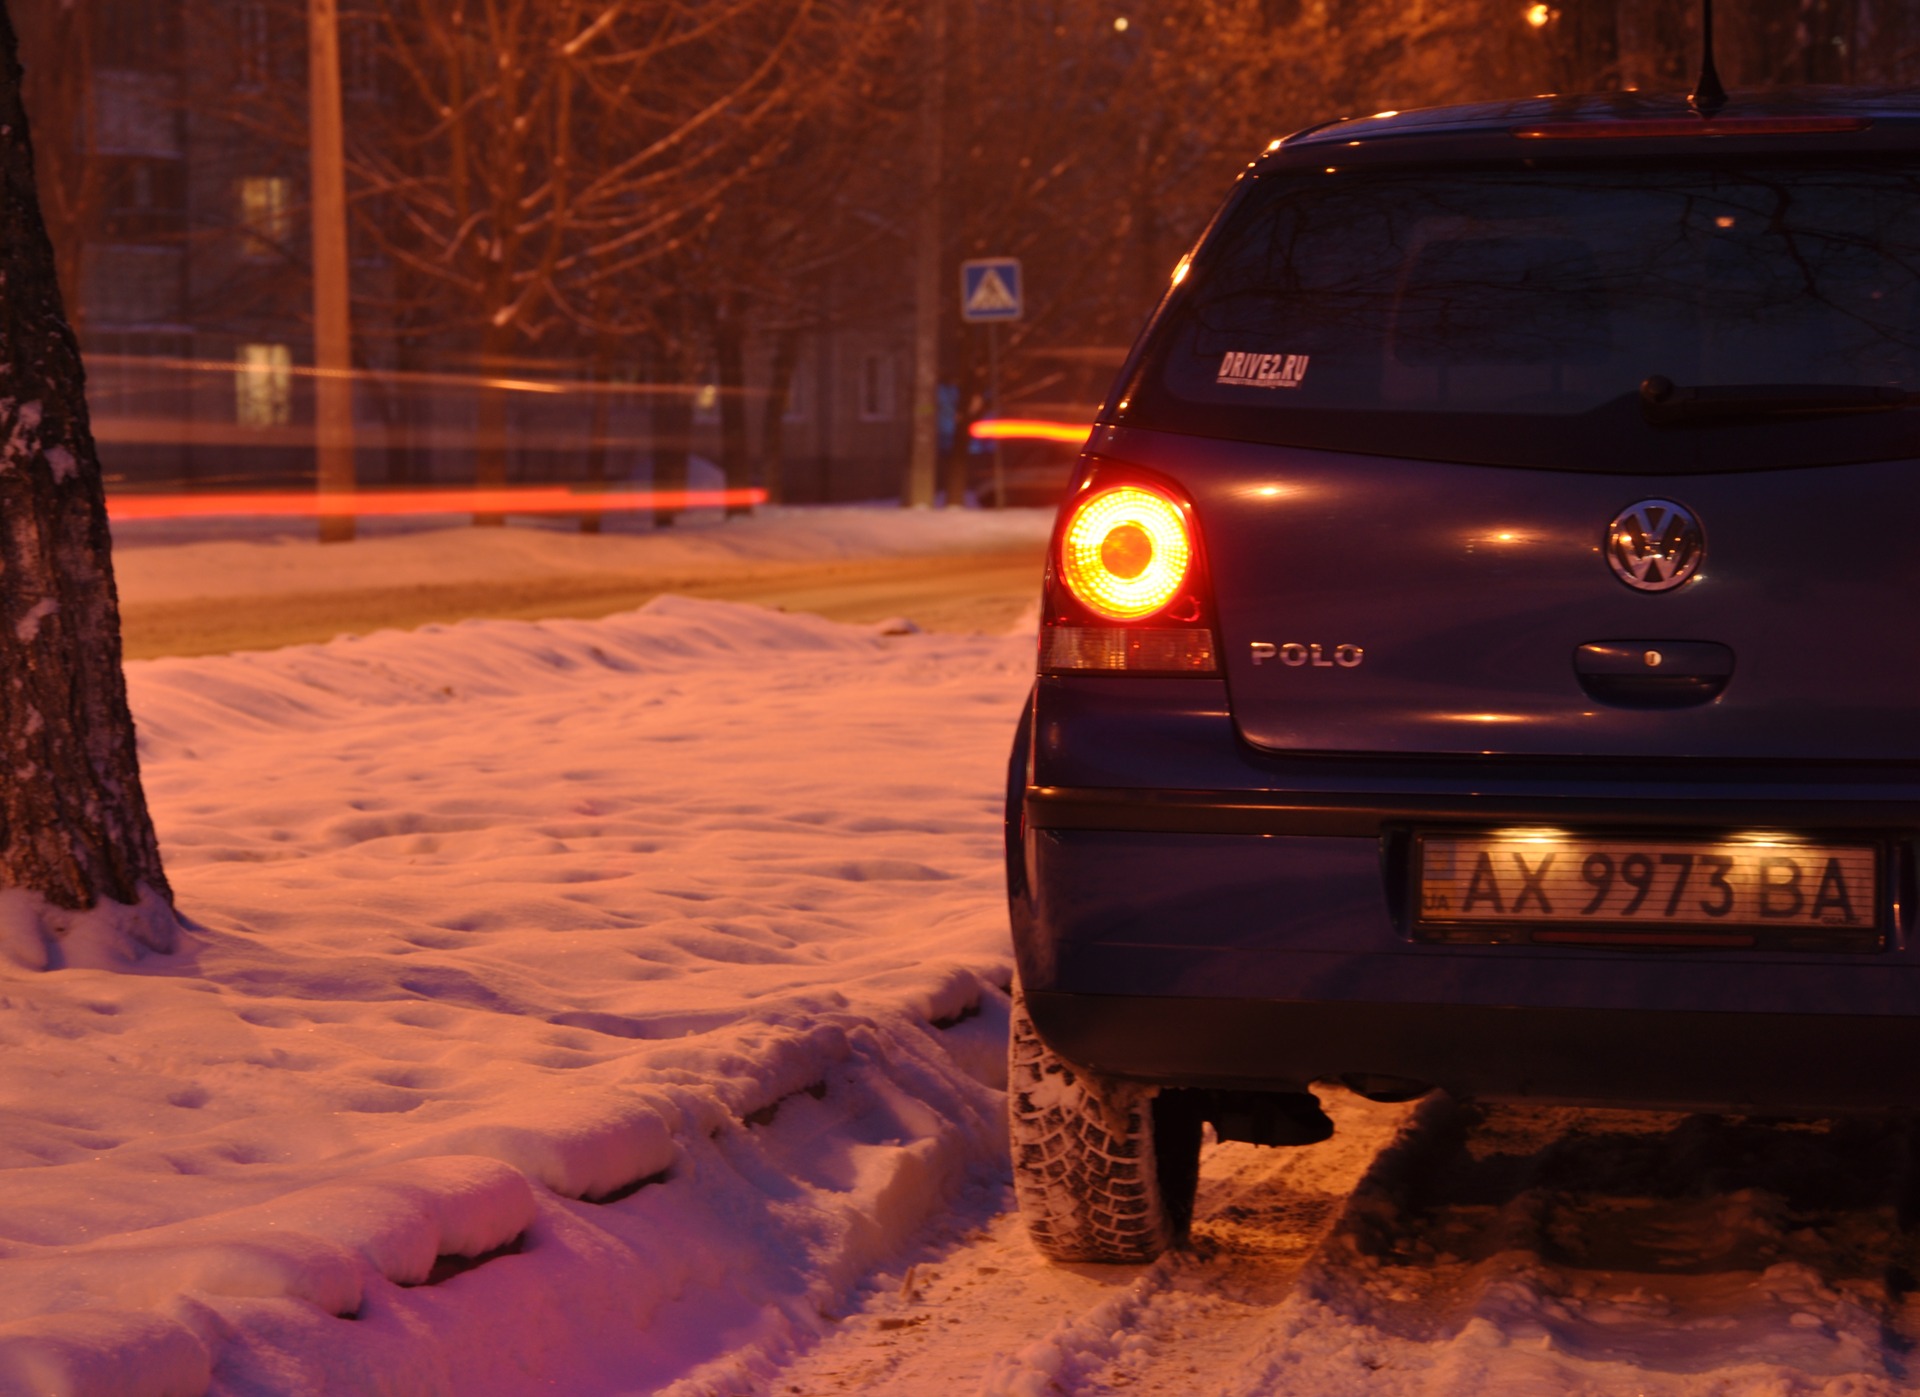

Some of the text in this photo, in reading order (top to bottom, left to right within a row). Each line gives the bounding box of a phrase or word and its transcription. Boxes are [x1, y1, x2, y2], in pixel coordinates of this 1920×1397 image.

[1217, 351, 1309, 381] DRIVE2.RU
[1250, 642, 1363, 668] POLO
[1462, 851, 1856, 921] AX 9973 BA
